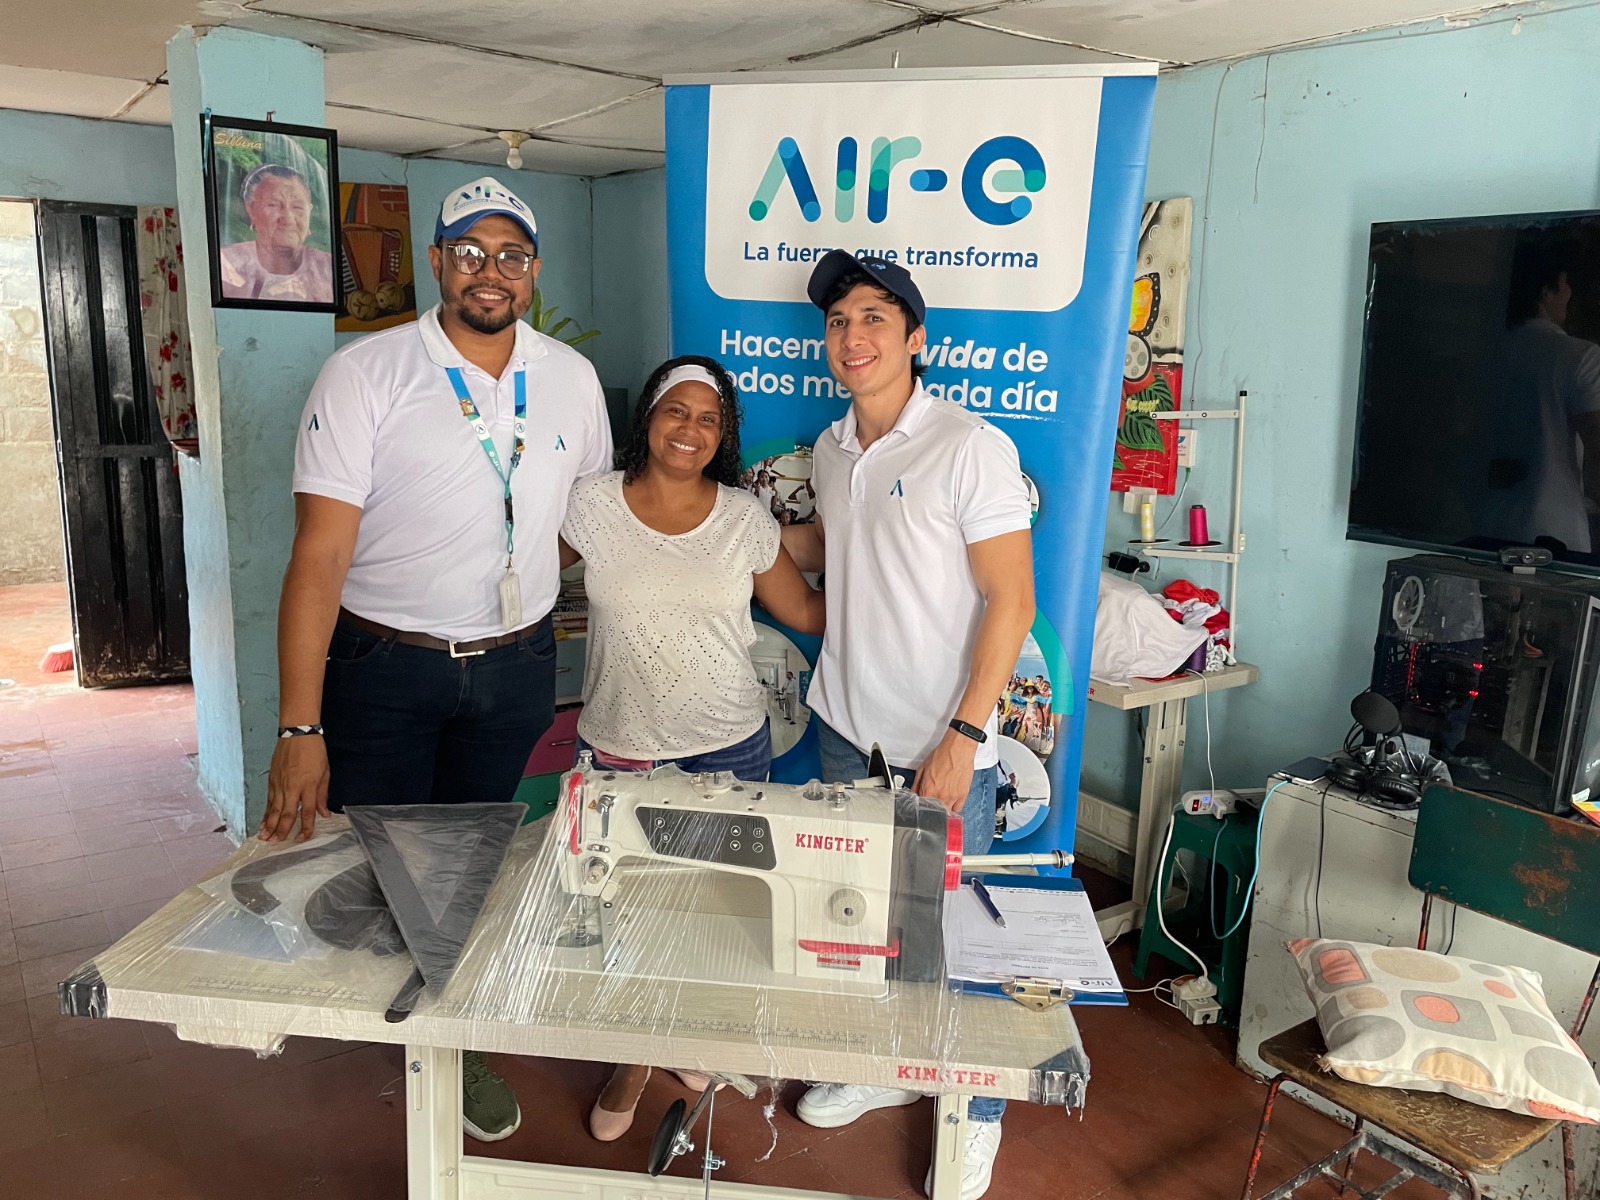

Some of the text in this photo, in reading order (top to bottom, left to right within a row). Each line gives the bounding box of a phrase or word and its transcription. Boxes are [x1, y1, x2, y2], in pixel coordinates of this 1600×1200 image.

[743, 241, 769, 261] La
[777, 241, 833, 262] fuer
[906, 246, 1039, 269] transforma
[720, 329, 1049, 373] Hacem vida de
[924, 378, 993, 409] ada
[1001, 380, 1058, 413] día
